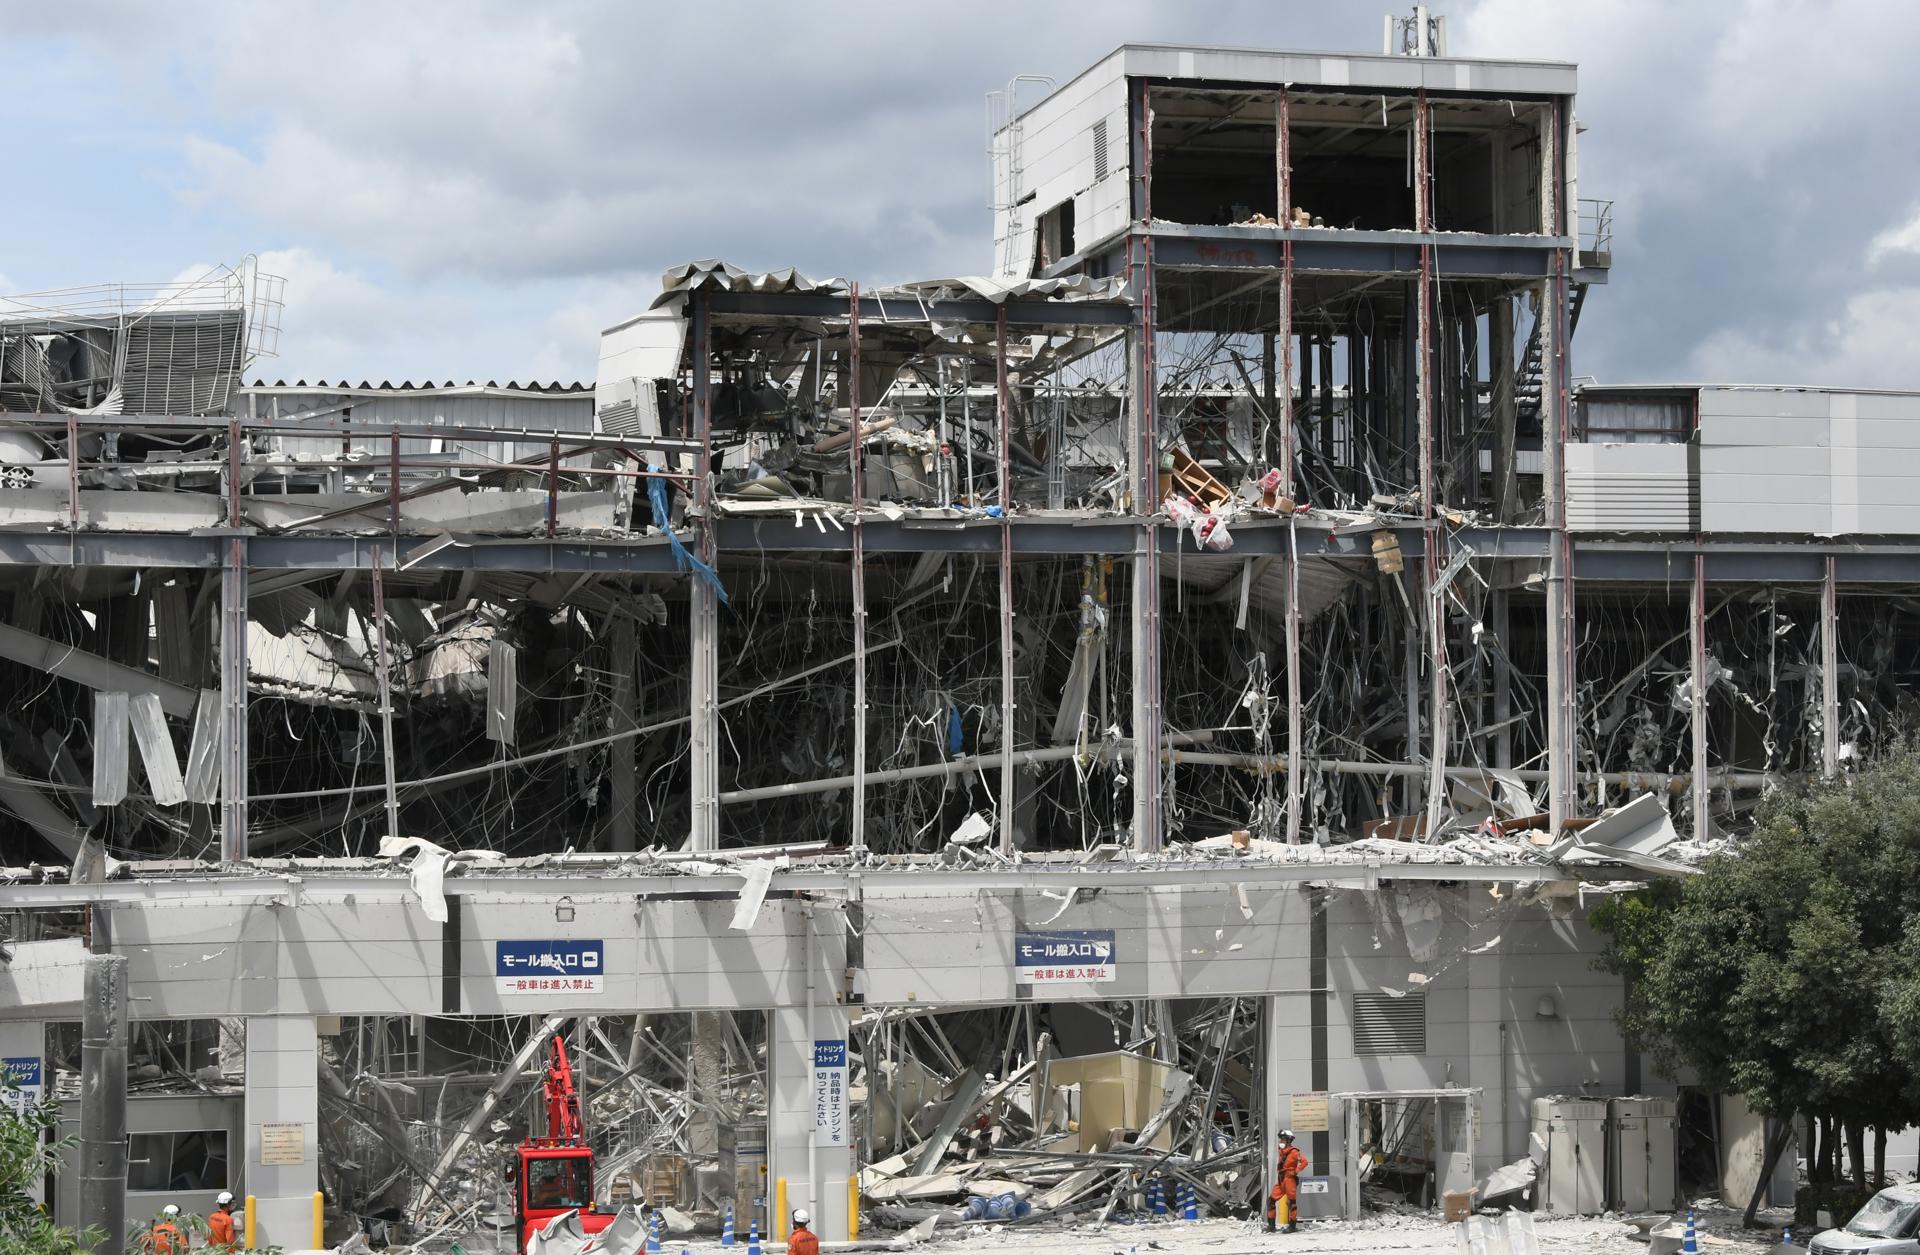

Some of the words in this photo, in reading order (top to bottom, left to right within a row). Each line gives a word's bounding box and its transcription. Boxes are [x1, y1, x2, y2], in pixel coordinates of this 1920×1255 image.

[1021, 944, 1091, 957] モール搬入口
[502, 953, 578, 967] モール搬入口
[1024, 968, 1107, 980] 一般車は進入禁止
[505, 979, 594, 990] 一般車は進入禁止
[817, 1055, 839, 1063] ストップ
[816, 1072, 827, 1126] 切ってください
[830, 1071, 841, 1142] 納品時はエンジンを
